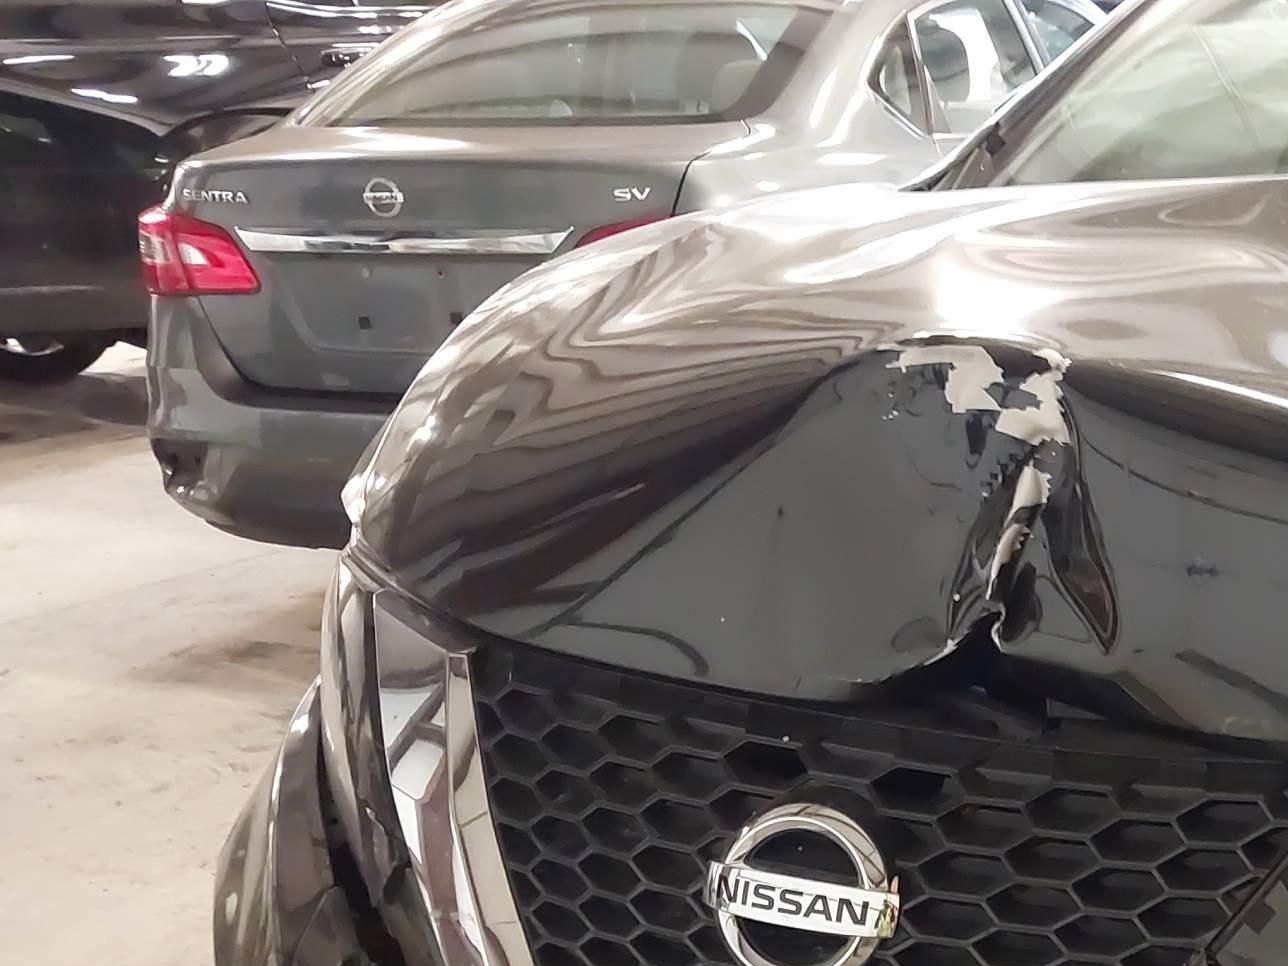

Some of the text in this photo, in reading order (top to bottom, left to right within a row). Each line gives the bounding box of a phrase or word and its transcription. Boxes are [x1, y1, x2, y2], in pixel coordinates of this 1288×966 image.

[182, 188, 249, 204] SENTRA
[613, 187, 651, 201] SV
[716, 873, 870, 927] NISSAN
